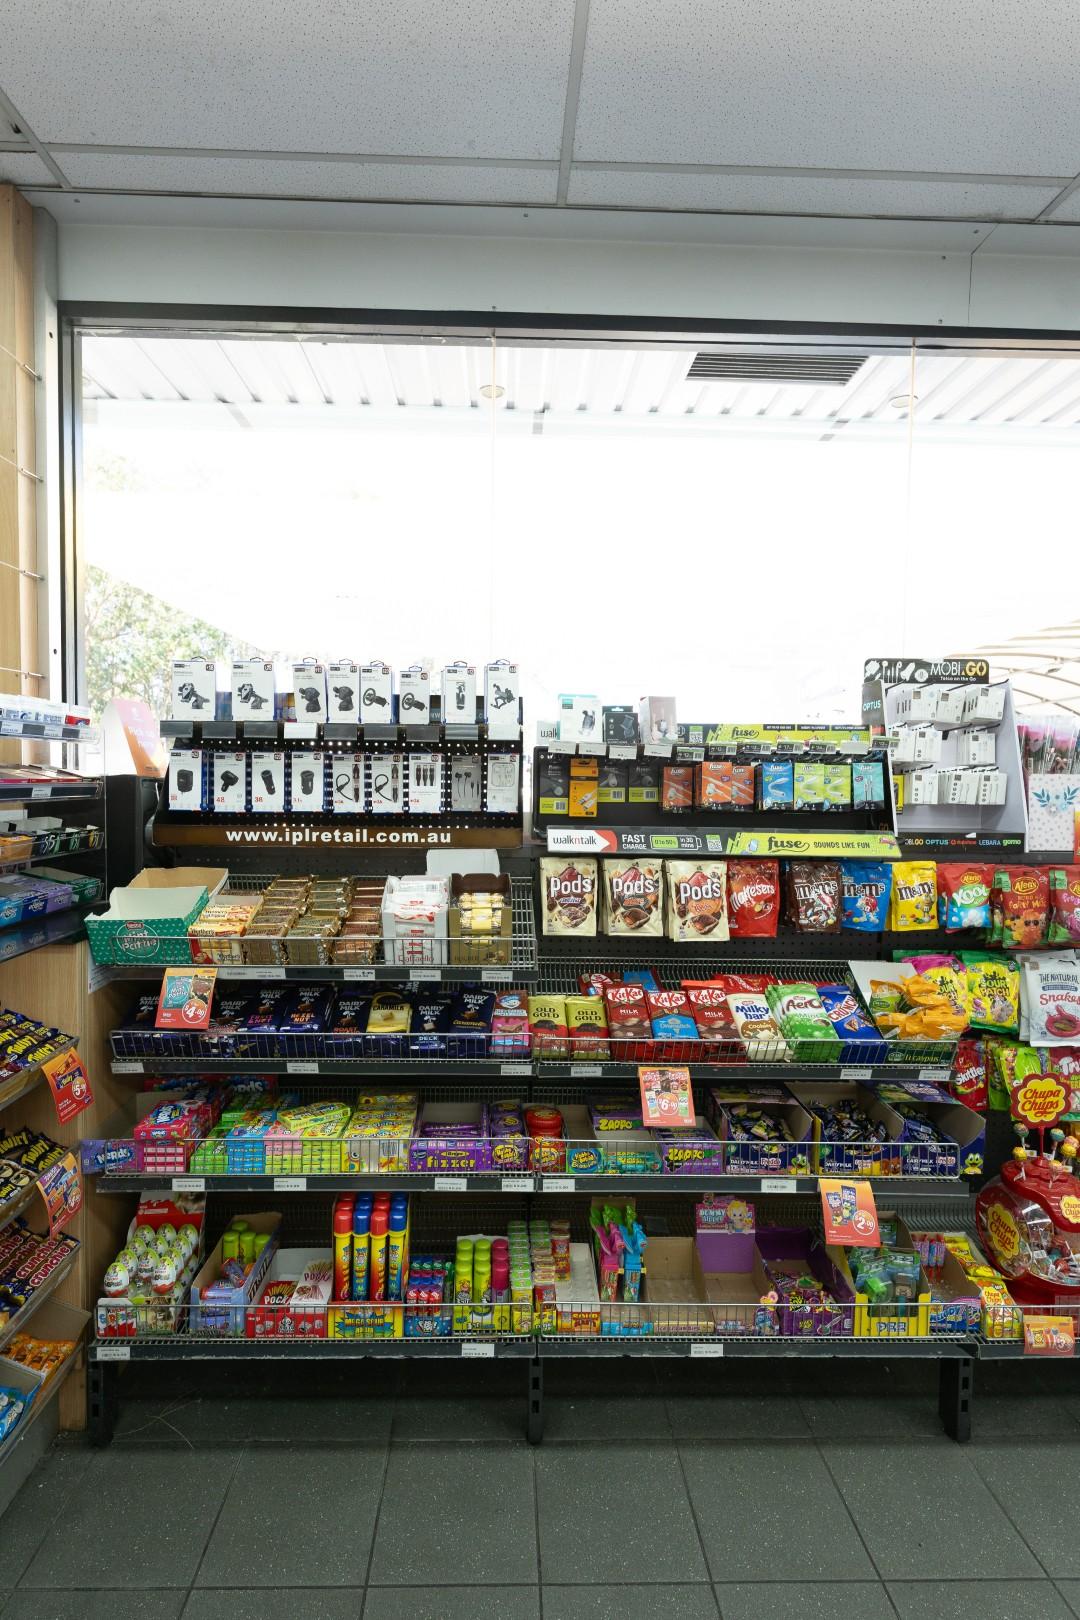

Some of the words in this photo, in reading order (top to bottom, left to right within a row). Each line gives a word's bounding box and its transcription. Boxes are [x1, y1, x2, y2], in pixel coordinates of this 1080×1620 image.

[862, 700, 882, 711] OPTUS
[226, 828, 451, 845] www.iplretail.com.au
[621, 834, 646, 843] FAST
[925, 838, 949, 846] OPTUS
[1002, 839, 1021, 847] gomo
[767, 836, 810, 853] fuse
[813, 841, 841, 849] SOUNDS
[550, 874, 592, 897] Pods
[612, 874, 655, 898] Pods
[680, 878, 721, 904] Pods
[730, 883, 775, 912] Maltesers
[1040, 973, 1050, 983] THE
[607, 987, 644, 1002] KitKat
[689, 989, 727, 1004] KitKat
[979, 987, 1010, 996] PATCH
[735, 1005, 769, 1015] Milky
[744, 1012, 766, 1020] bar
[1023, 1088, 1062, 1099] Chupa
[1021, 1099, 1060, 1113] Chups
[426, 1155, 476, 1168] fizzer
[991, 1211, 1017, 1239] Chupa
[989, 1221, 1015, 1249] Chups
[29, 1246, 71, 1287] Crunchie
